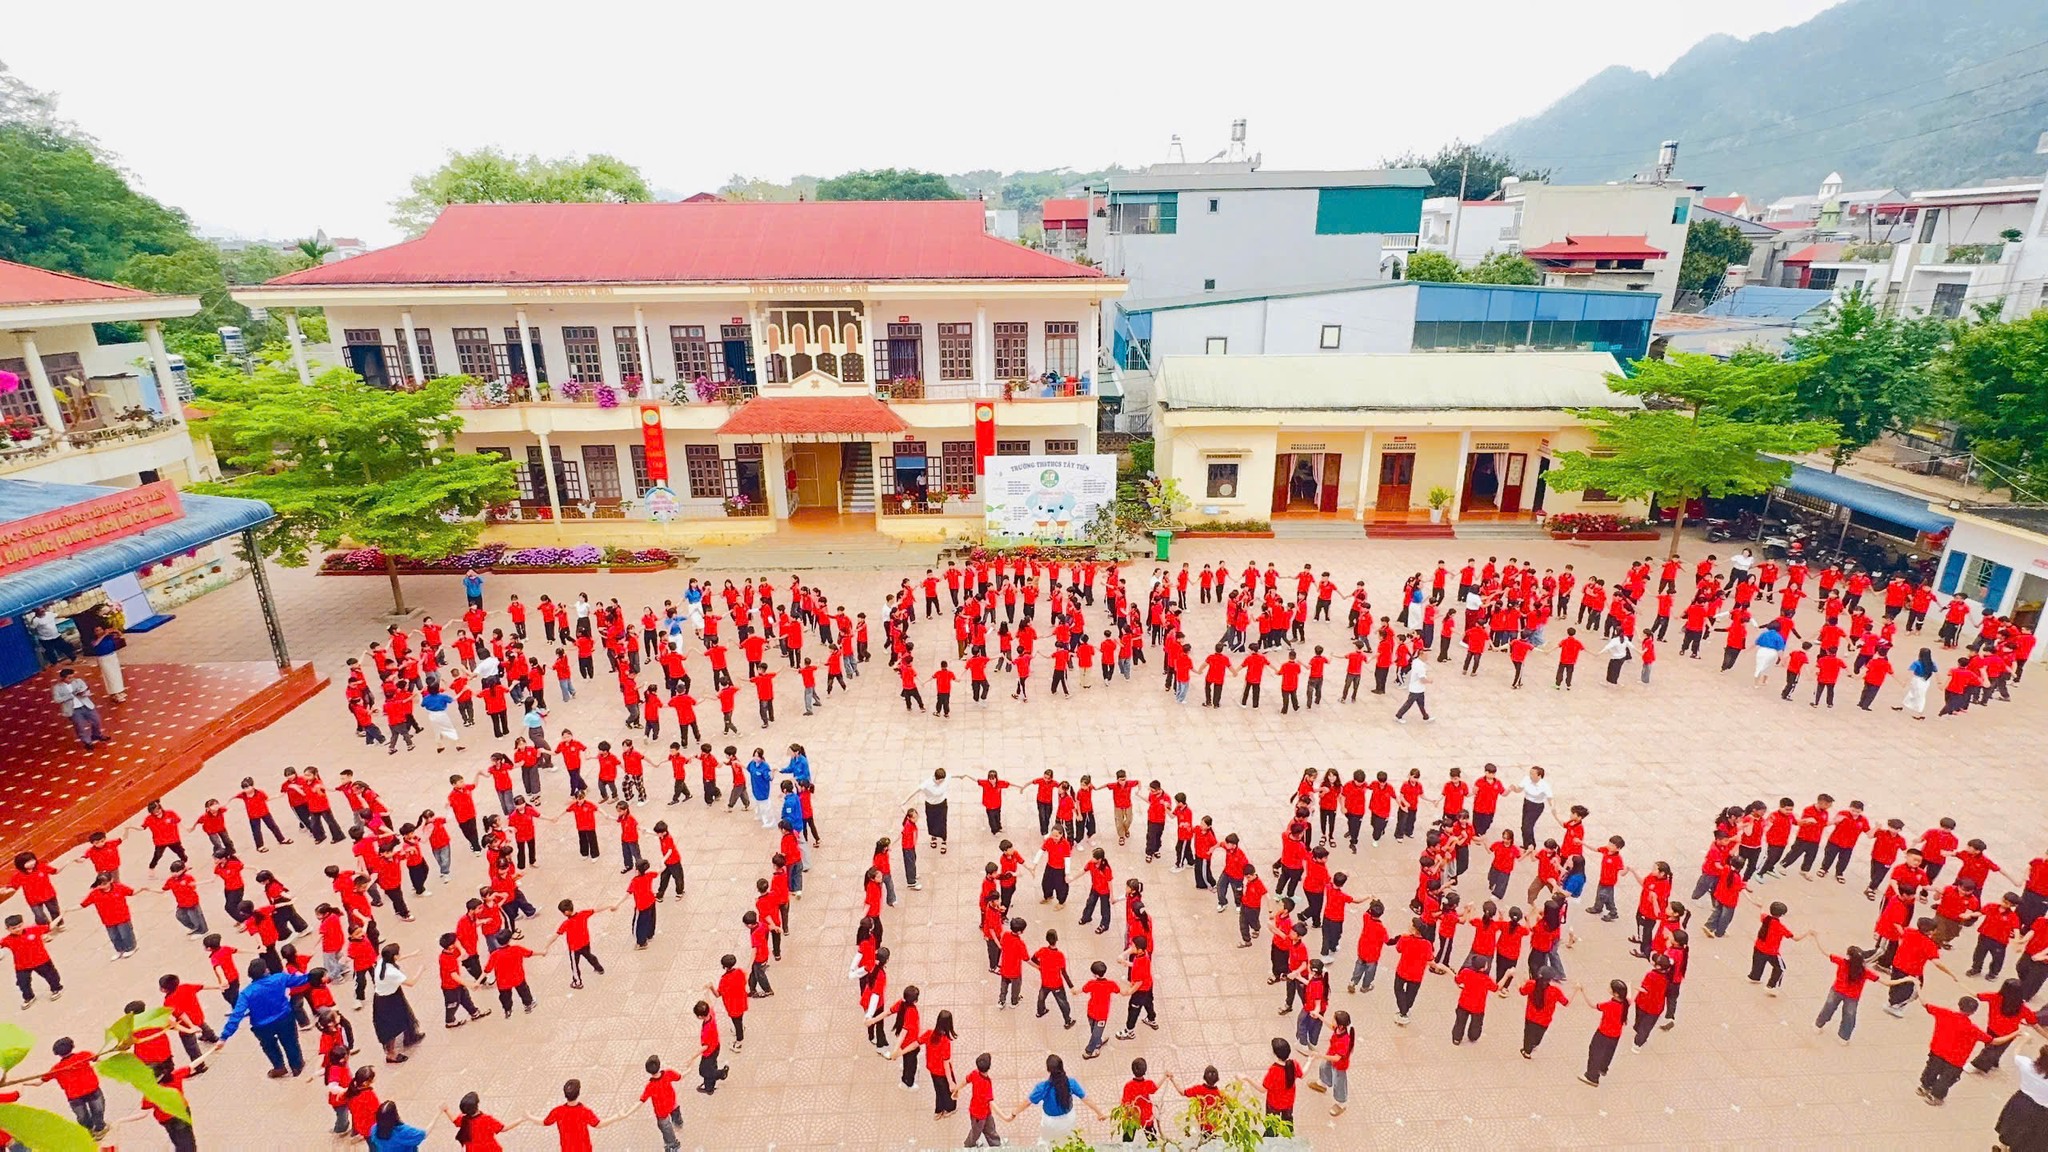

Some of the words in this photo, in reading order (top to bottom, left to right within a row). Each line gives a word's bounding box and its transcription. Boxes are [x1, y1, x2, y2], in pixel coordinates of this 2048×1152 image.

[1010, 461, 1035, 472] TRƯỜNG
[1063, 460, 1076, 469] TÂY
[5, 546, 30, 565] ĐẠO
[56, 527, 92, 547] PHONG
[94, 517, 119, 537] CÁCH
[118, 511, 134, 530] HỒ
[133, 507, 150, 525] CHÍ
[149, 504, 173, 520] MINH
[19, 523, 46, 540] SINH
[44, 513, 84, 534] TRƯỜNG
[84, 505, 108, 521] TIỂU
[106, 501, 128, 515] HỌC
[127, 494, 146, 508] TÂY
[147, 488, 167, 503] TIẾN
